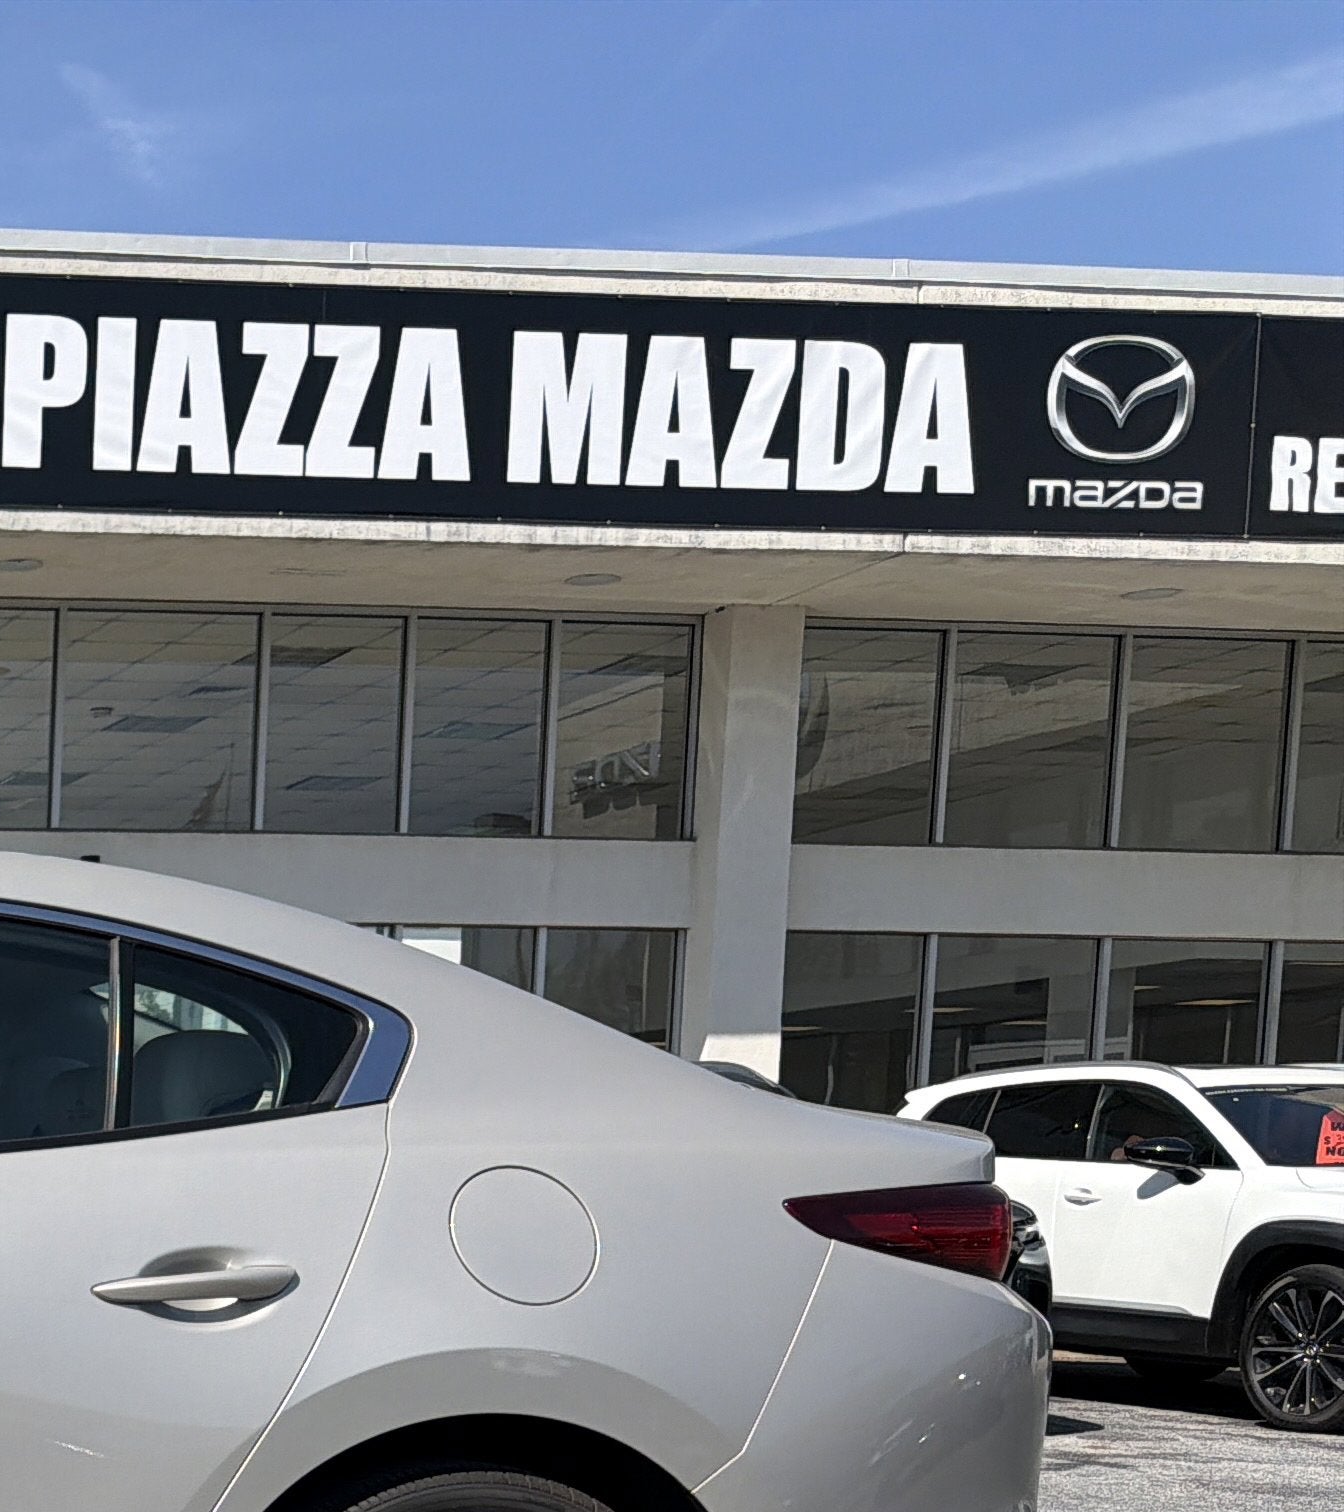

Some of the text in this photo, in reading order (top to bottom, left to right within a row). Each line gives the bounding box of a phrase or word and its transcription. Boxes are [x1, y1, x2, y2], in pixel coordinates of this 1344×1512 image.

[2, 313, 975, 494] PIAZZA MAZDA
[1028, 479, 1204, 510] mazda
